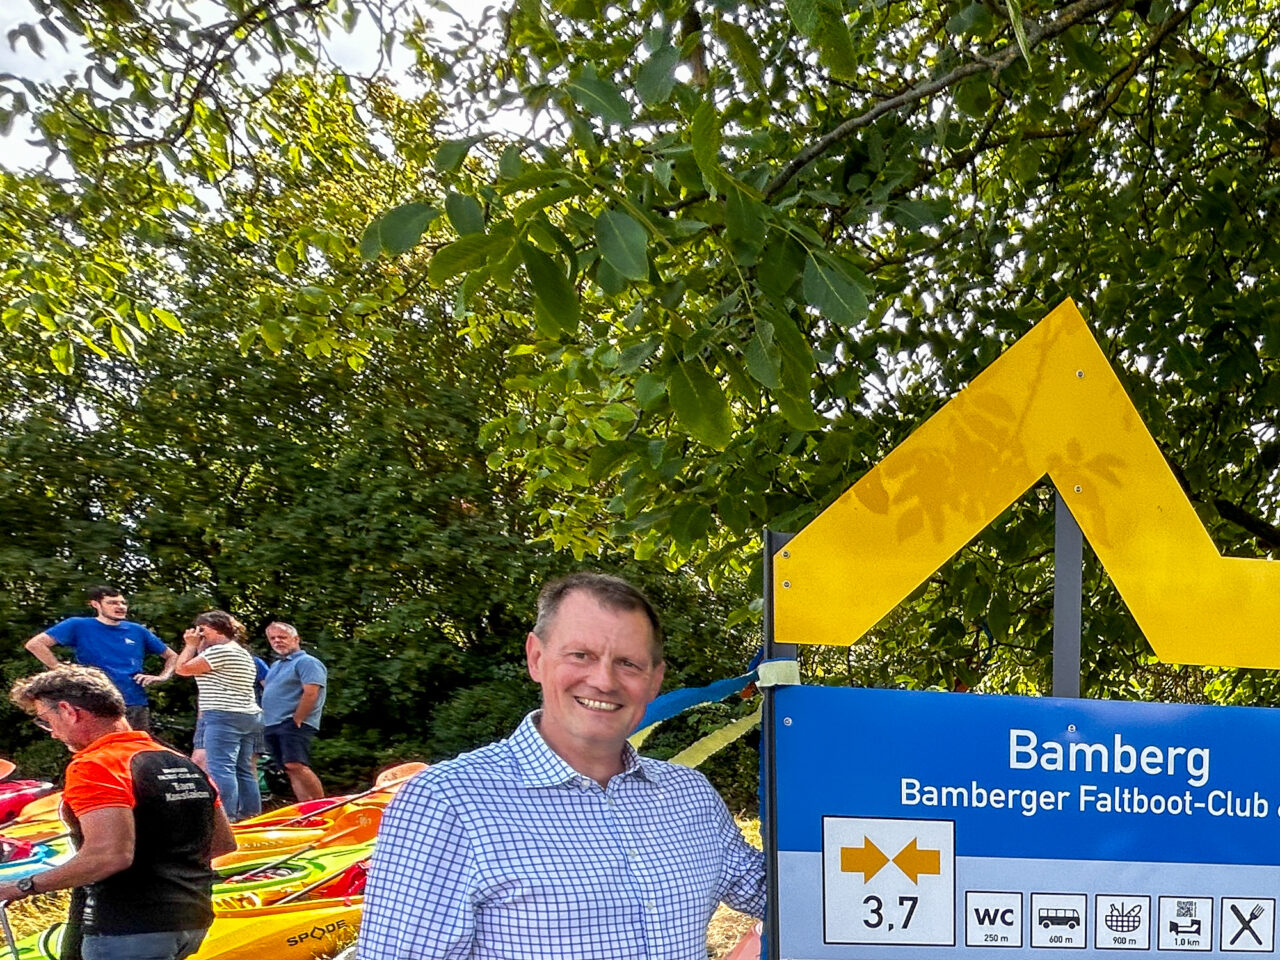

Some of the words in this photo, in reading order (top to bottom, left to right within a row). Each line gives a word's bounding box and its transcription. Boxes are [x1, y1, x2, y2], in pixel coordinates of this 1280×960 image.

[1009, 728, 1210, 787] Bamberg
[901, 777, 1070, 817] Bamberger
[1079, 784, 1269, 819] Faltboot-Club
[862, 894, 919, 932] 3,7
[974, 908, 1014, 927] WC
[984, 934, 999, 943] 250
[1000, 935, 1009, 943] m
[1048, 936, 1063, 945] 600
[1064, 936, 1073, 945] m
[1112, 936, 1127, 946] 900
[1128, 937, 1137, 946] m
[1174, 937, 1186, 947] 1,0
[1187, 937, 1200, 947] km
